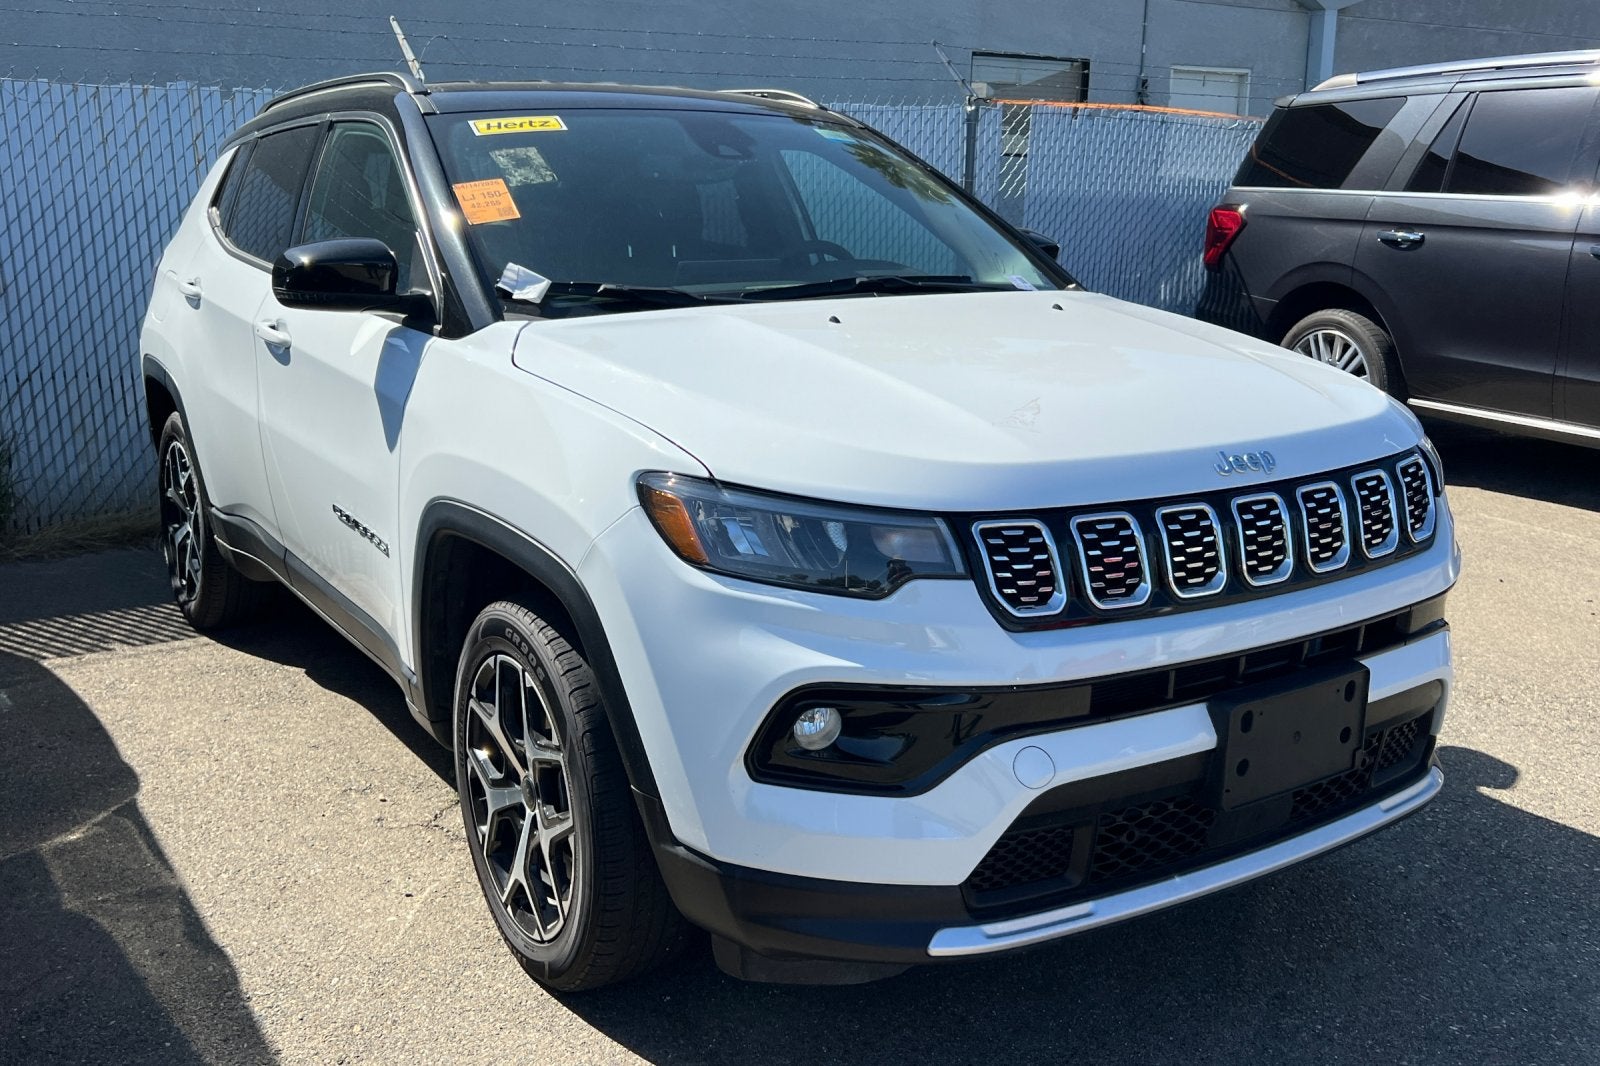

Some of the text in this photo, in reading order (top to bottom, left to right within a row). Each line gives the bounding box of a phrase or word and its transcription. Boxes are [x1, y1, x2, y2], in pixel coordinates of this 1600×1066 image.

[486, 119, 552, 131] Hertz
[479, 190, 502, 200] 150
[1213, 449, 1277, 477] Jeep
